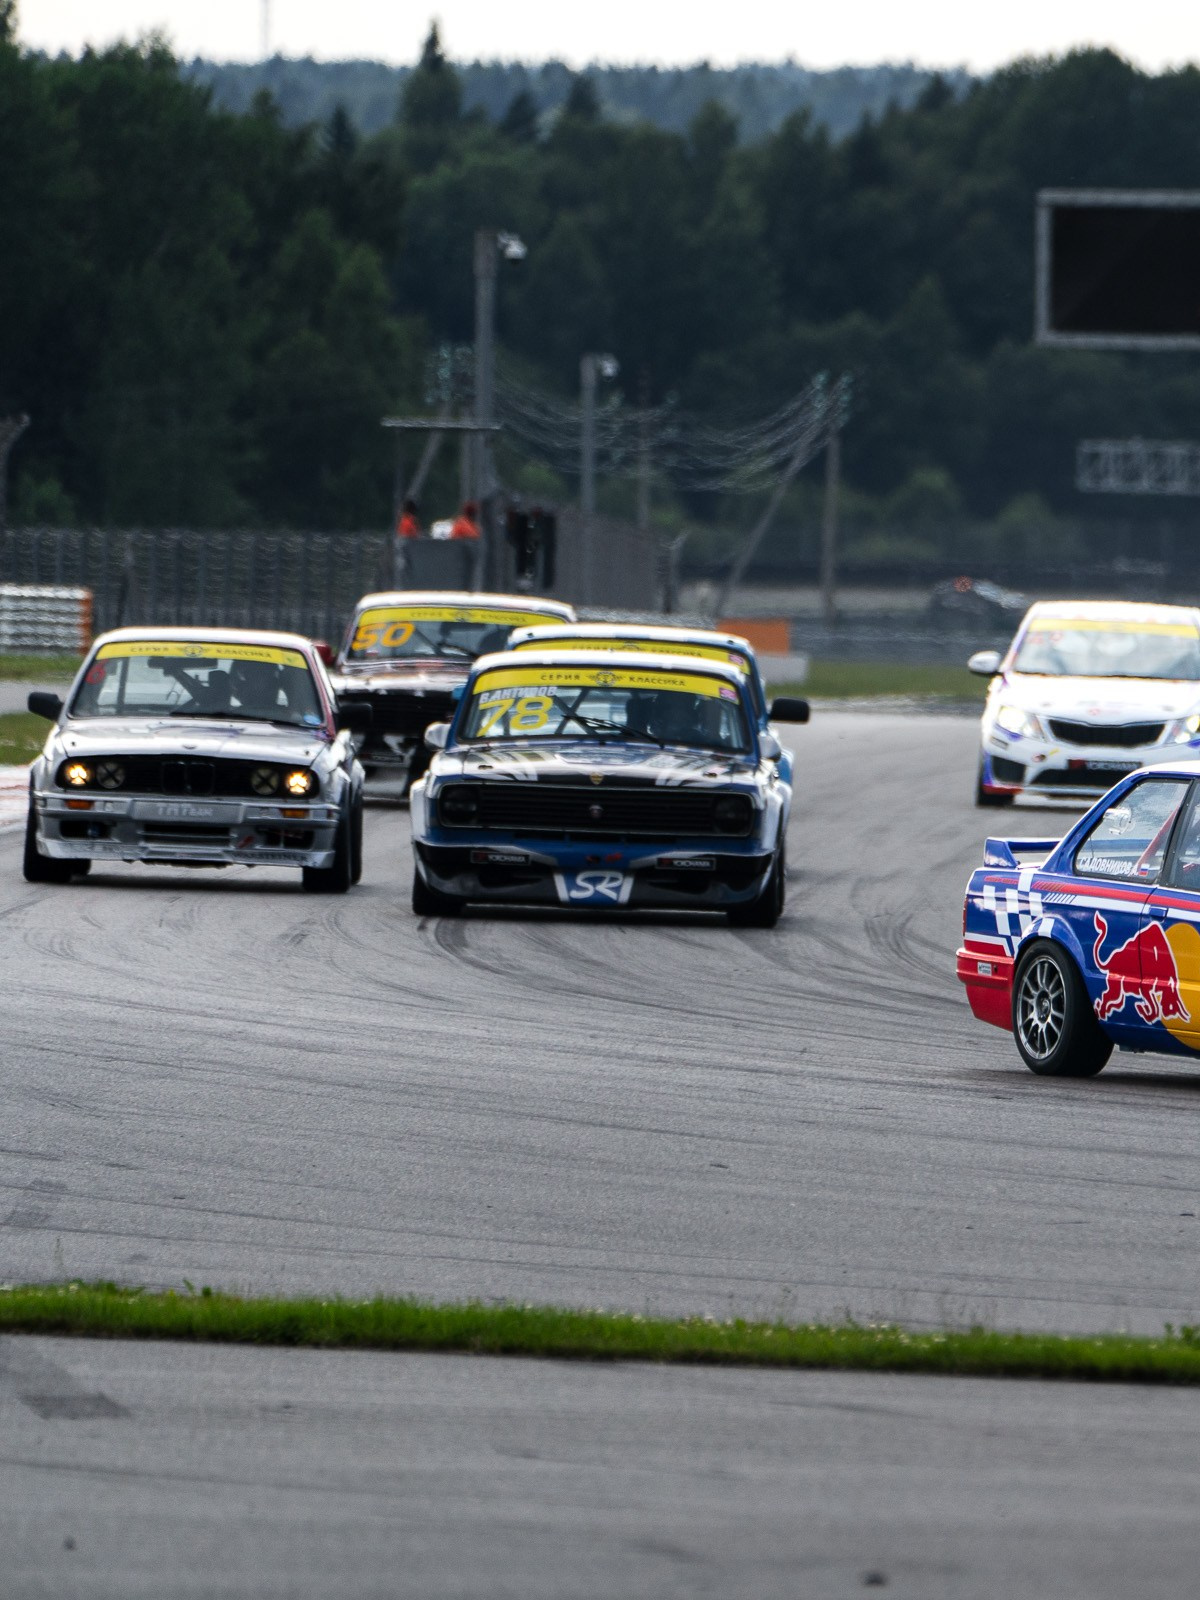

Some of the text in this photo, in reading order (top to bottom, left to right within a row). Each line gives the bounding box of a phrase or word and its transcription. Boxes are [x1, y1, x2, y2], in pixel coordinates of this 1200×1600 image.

[351, 622, 416, 651] 50
[540, 674, 687, 688] СЕРИЯ КЛАССИКА
[476, 696, 554, 737] 78
